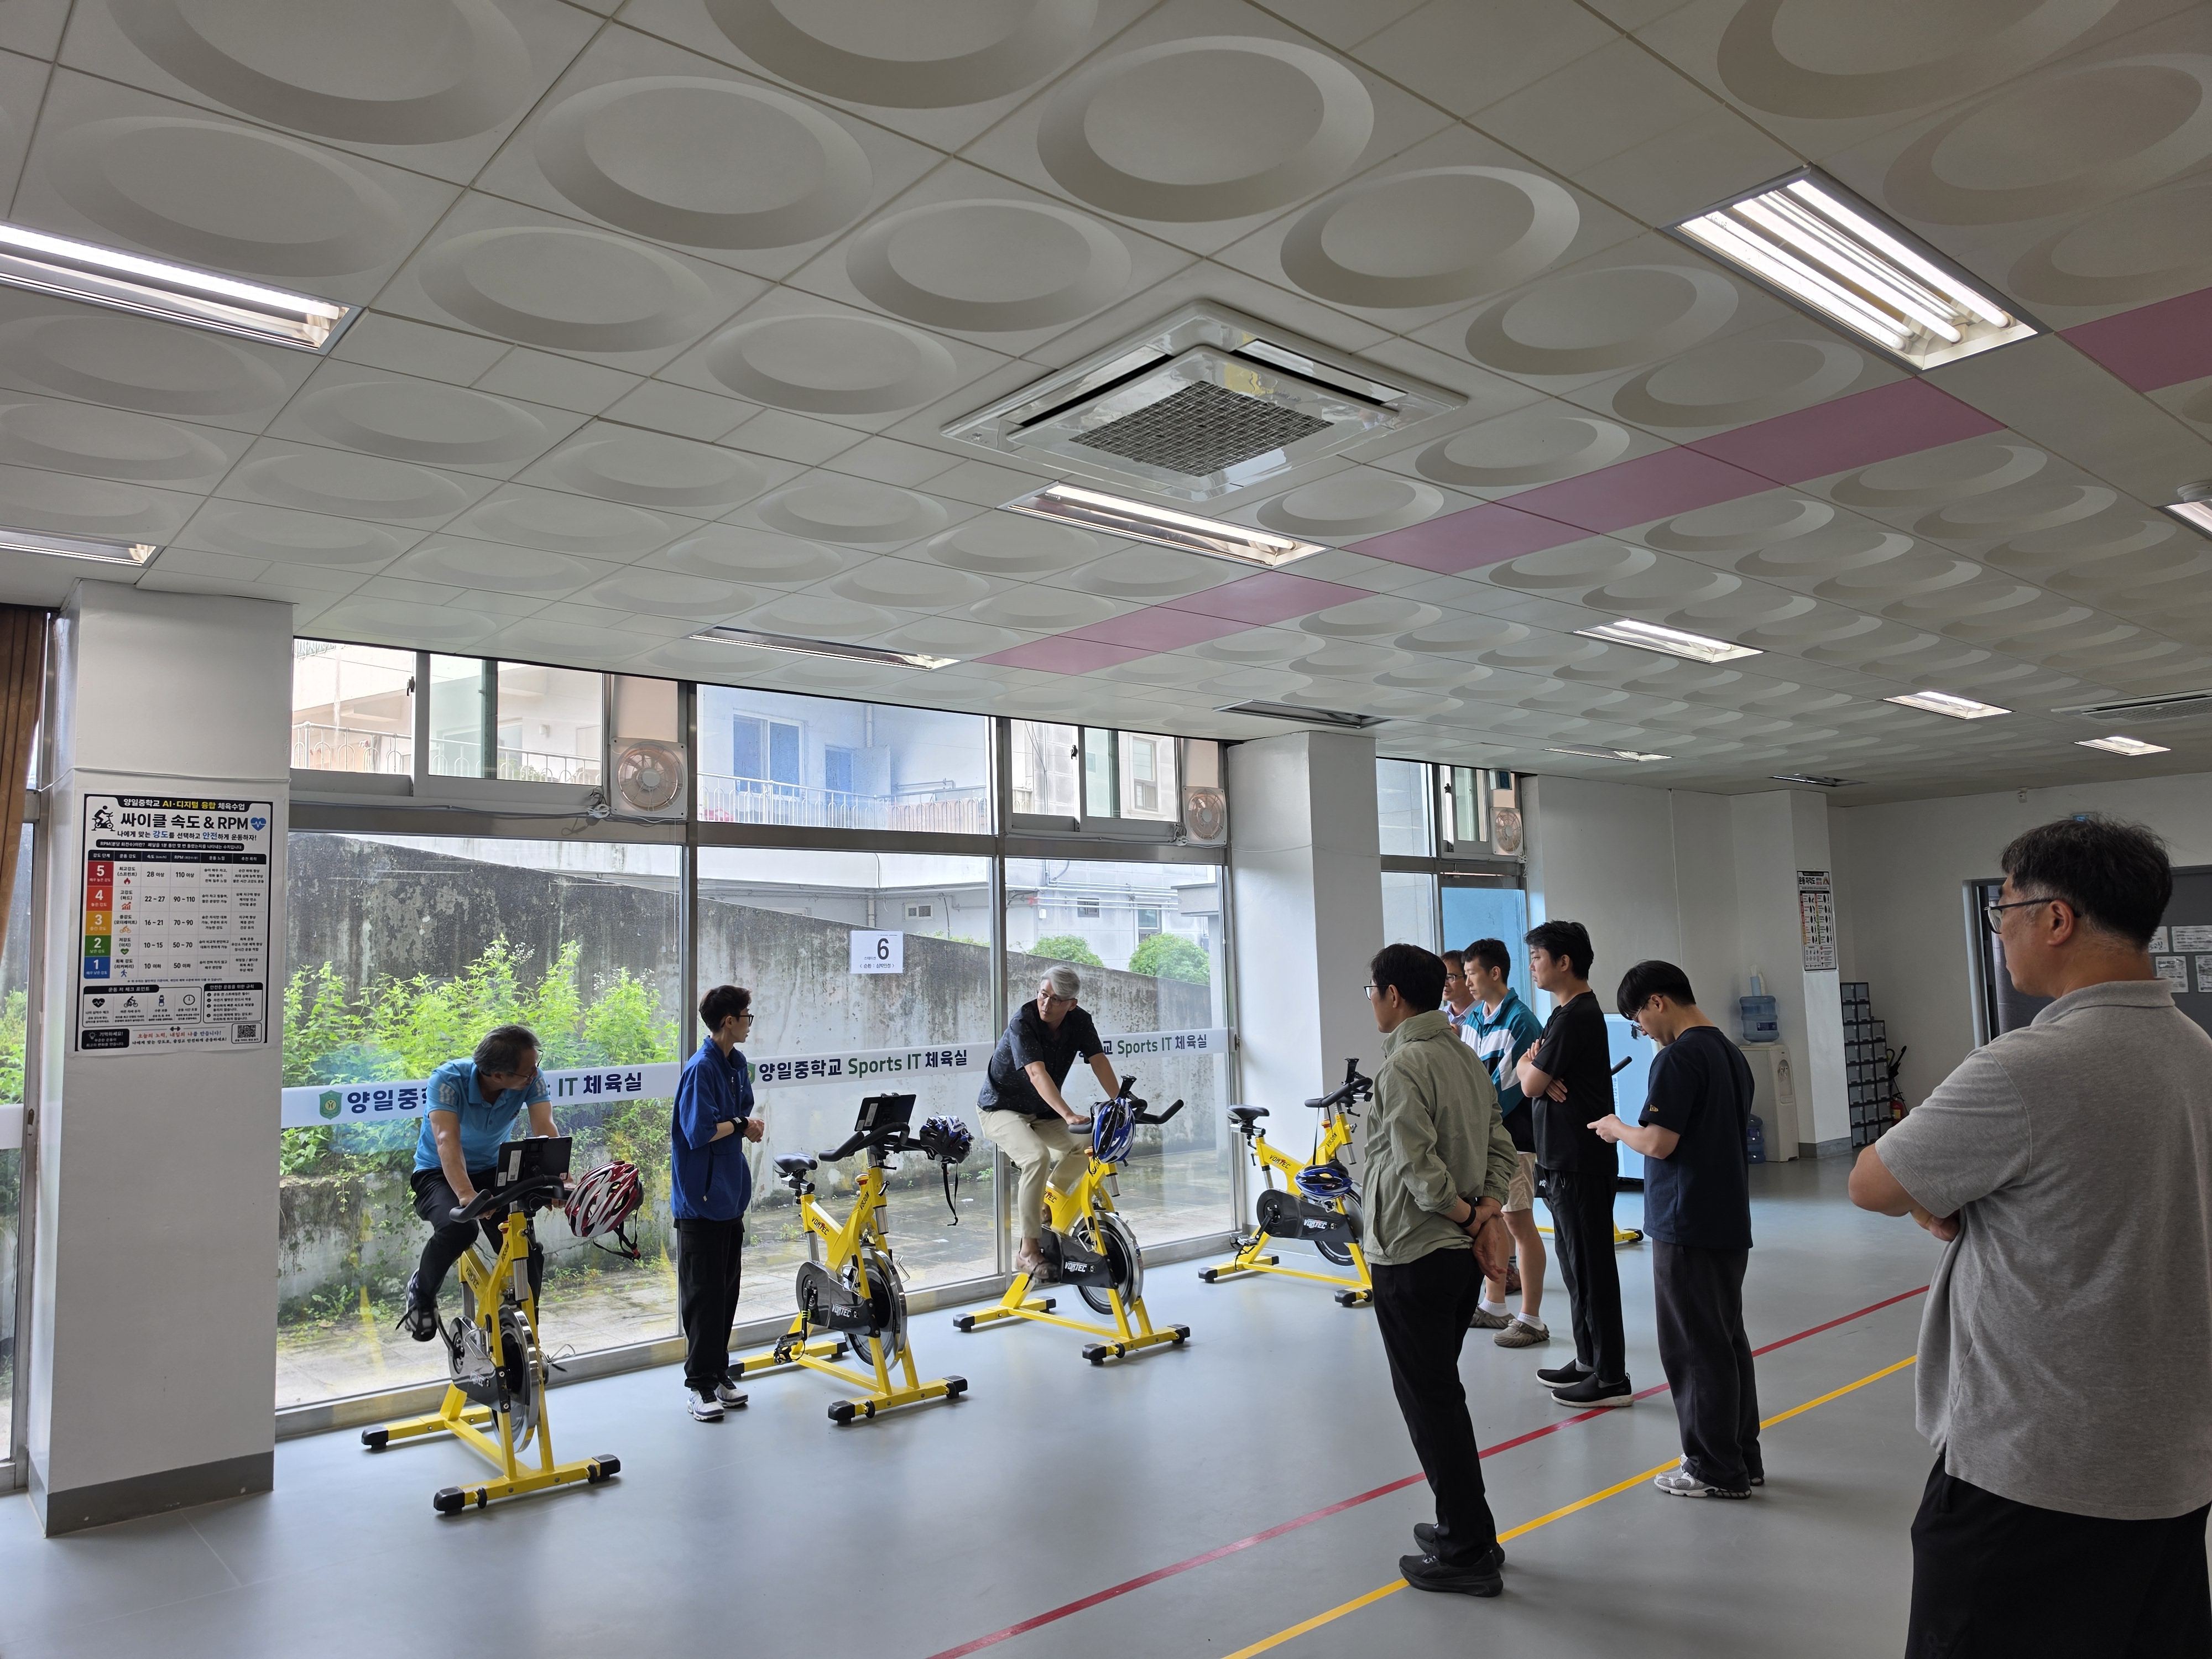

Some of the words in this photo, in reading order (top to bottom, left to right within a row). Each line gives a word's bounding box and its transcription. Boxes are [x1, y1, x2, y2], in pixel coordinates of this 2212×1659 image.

[121, 813, 166, 828] 싸이클
[171, 815, 200, 828] 속도
[204, 816, 214, 829] &
[218, 817, 248, 830] RPM
[202, 832, 229, 841] 안전하게
[97, 865, 104, 876] 5
[95, 890, 103, 900] 4
[95, 915, 102, 925] 3
[94, 938, 101, 948] 2
[878, 938, 889, 960] 6
[93, 959, 98, 969] 1
[1118, 1040, 1157, 1057] Sports
[1162, 1037, 1172, 1051] IT
[1175, 1034, 1207, 1050] 체육실
[759, 1058, 842, 1082] 양일중학교
[848, 1057, 902, 1078] Sports
[907, 1053, 921, 1070] IT
[925, 1050, 967, 1068] 체육실
[559, 1077, 578, 1097] IT
[583, 1072, 641, 1094] 체육실
[1269, 1155, 1291, 1169] VORTEC
[859, 1191, 869, 1210] V830N
[811, 1217, 830, 1235] VORTEC
[1304, 1219, 1327, 1229] VORTEC
[1065, 1261, 1087, 1272] VORTEC
[832, 1303, 852, 1317] VORTEC
